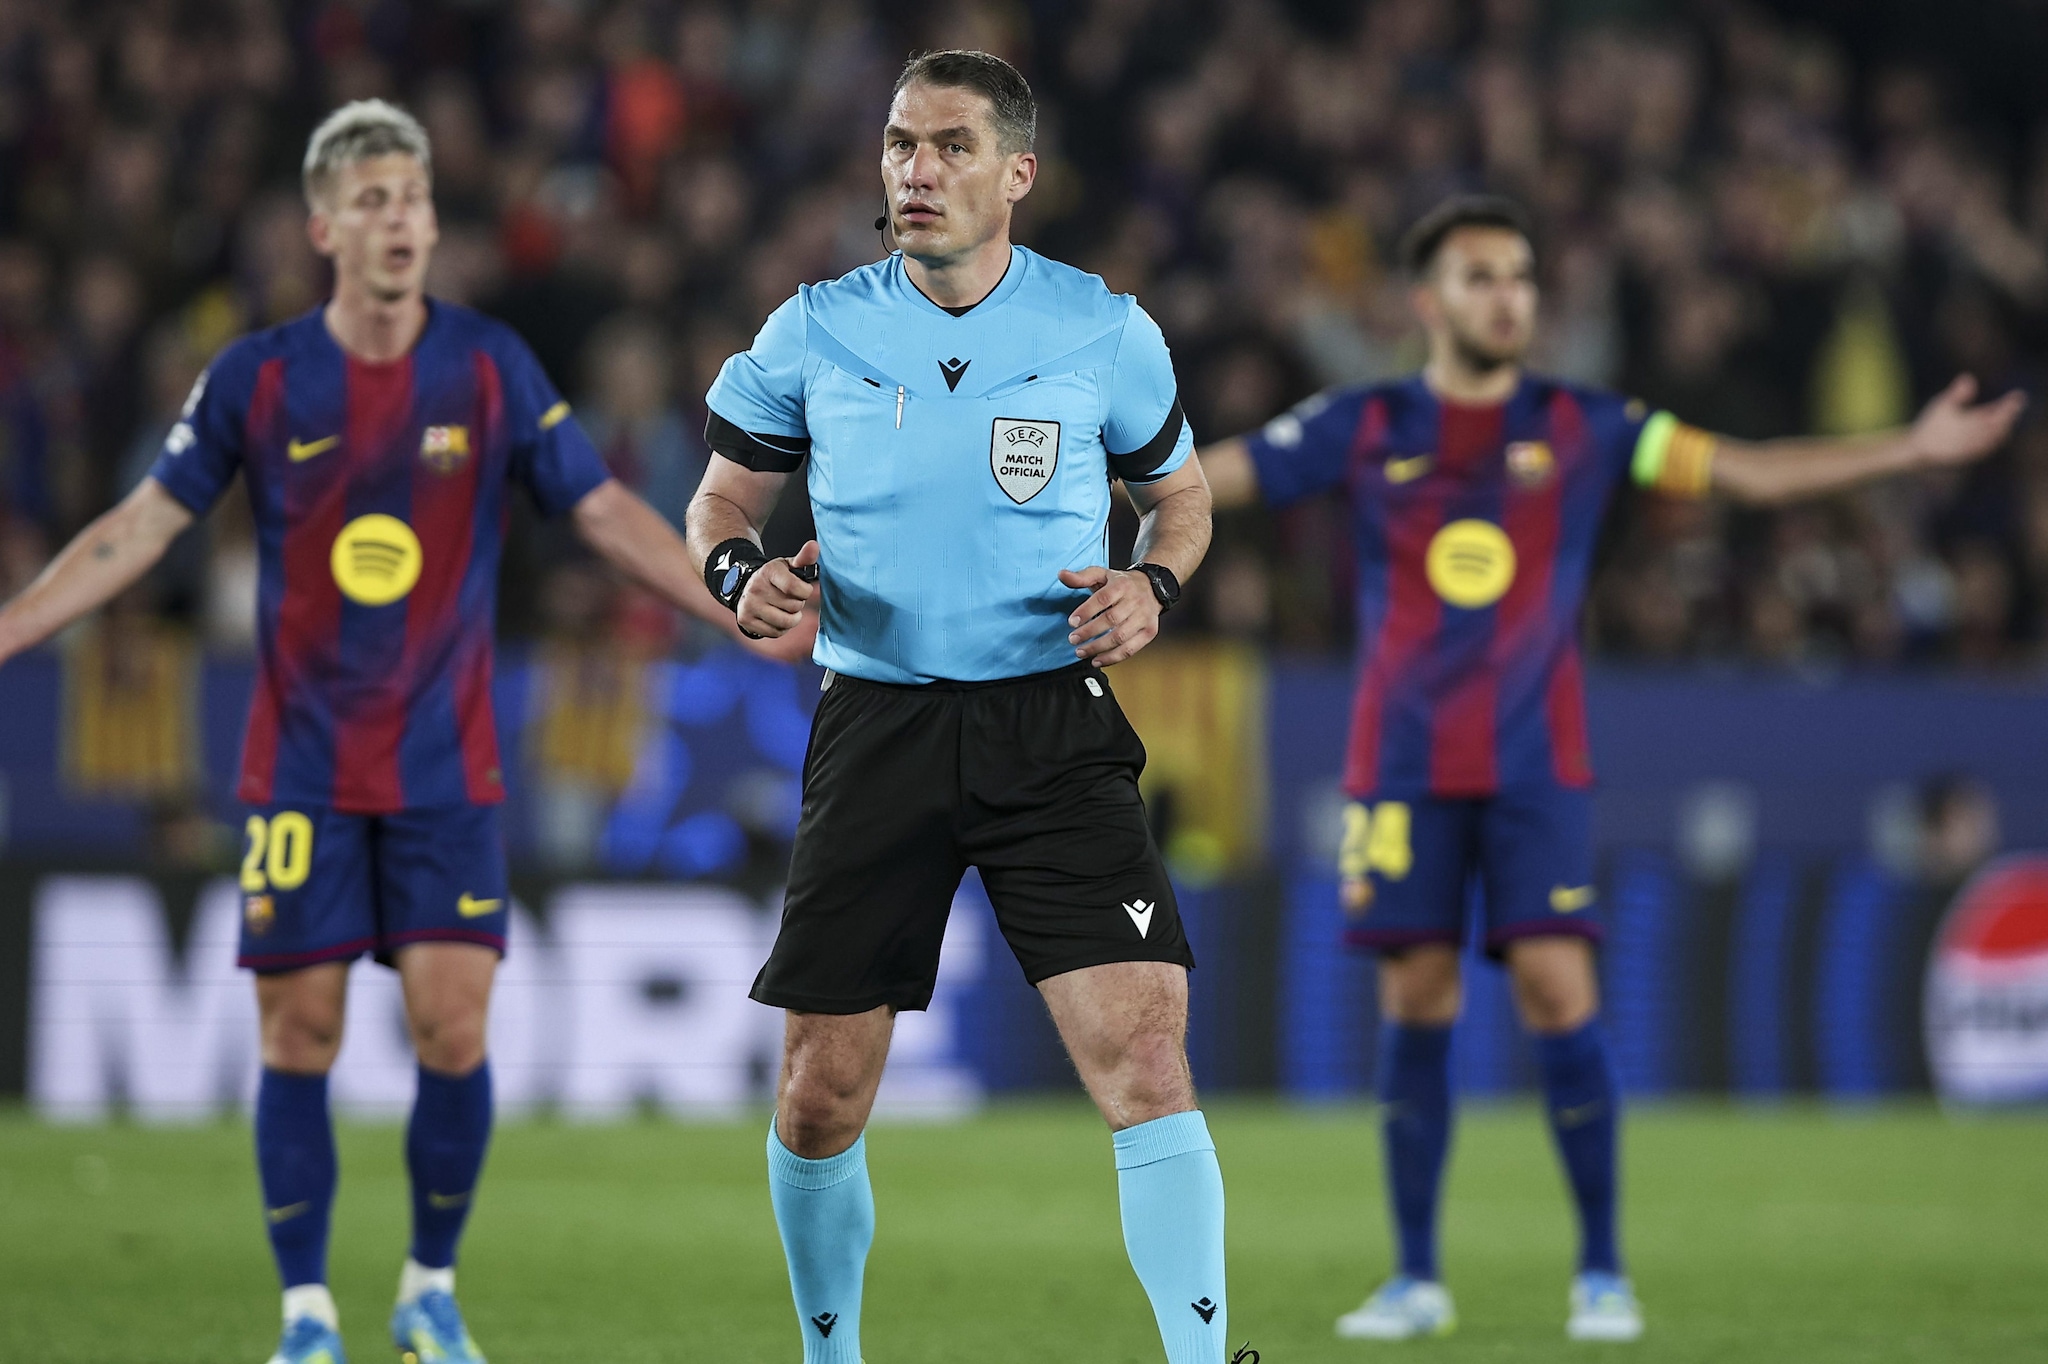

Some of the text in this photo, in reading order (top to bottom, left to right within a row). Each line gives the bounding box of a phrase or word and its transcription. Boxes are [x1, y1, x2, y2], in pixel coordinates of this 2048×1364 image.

[1006, 429, 1044, 446] UEFA
[1005, 454, 1043, 465] MATCH
[1000, 466, 1046, 478] OFFICIAL
[1340, 801, 1412, 880] 24
[241, 811, 313, 891] 20
